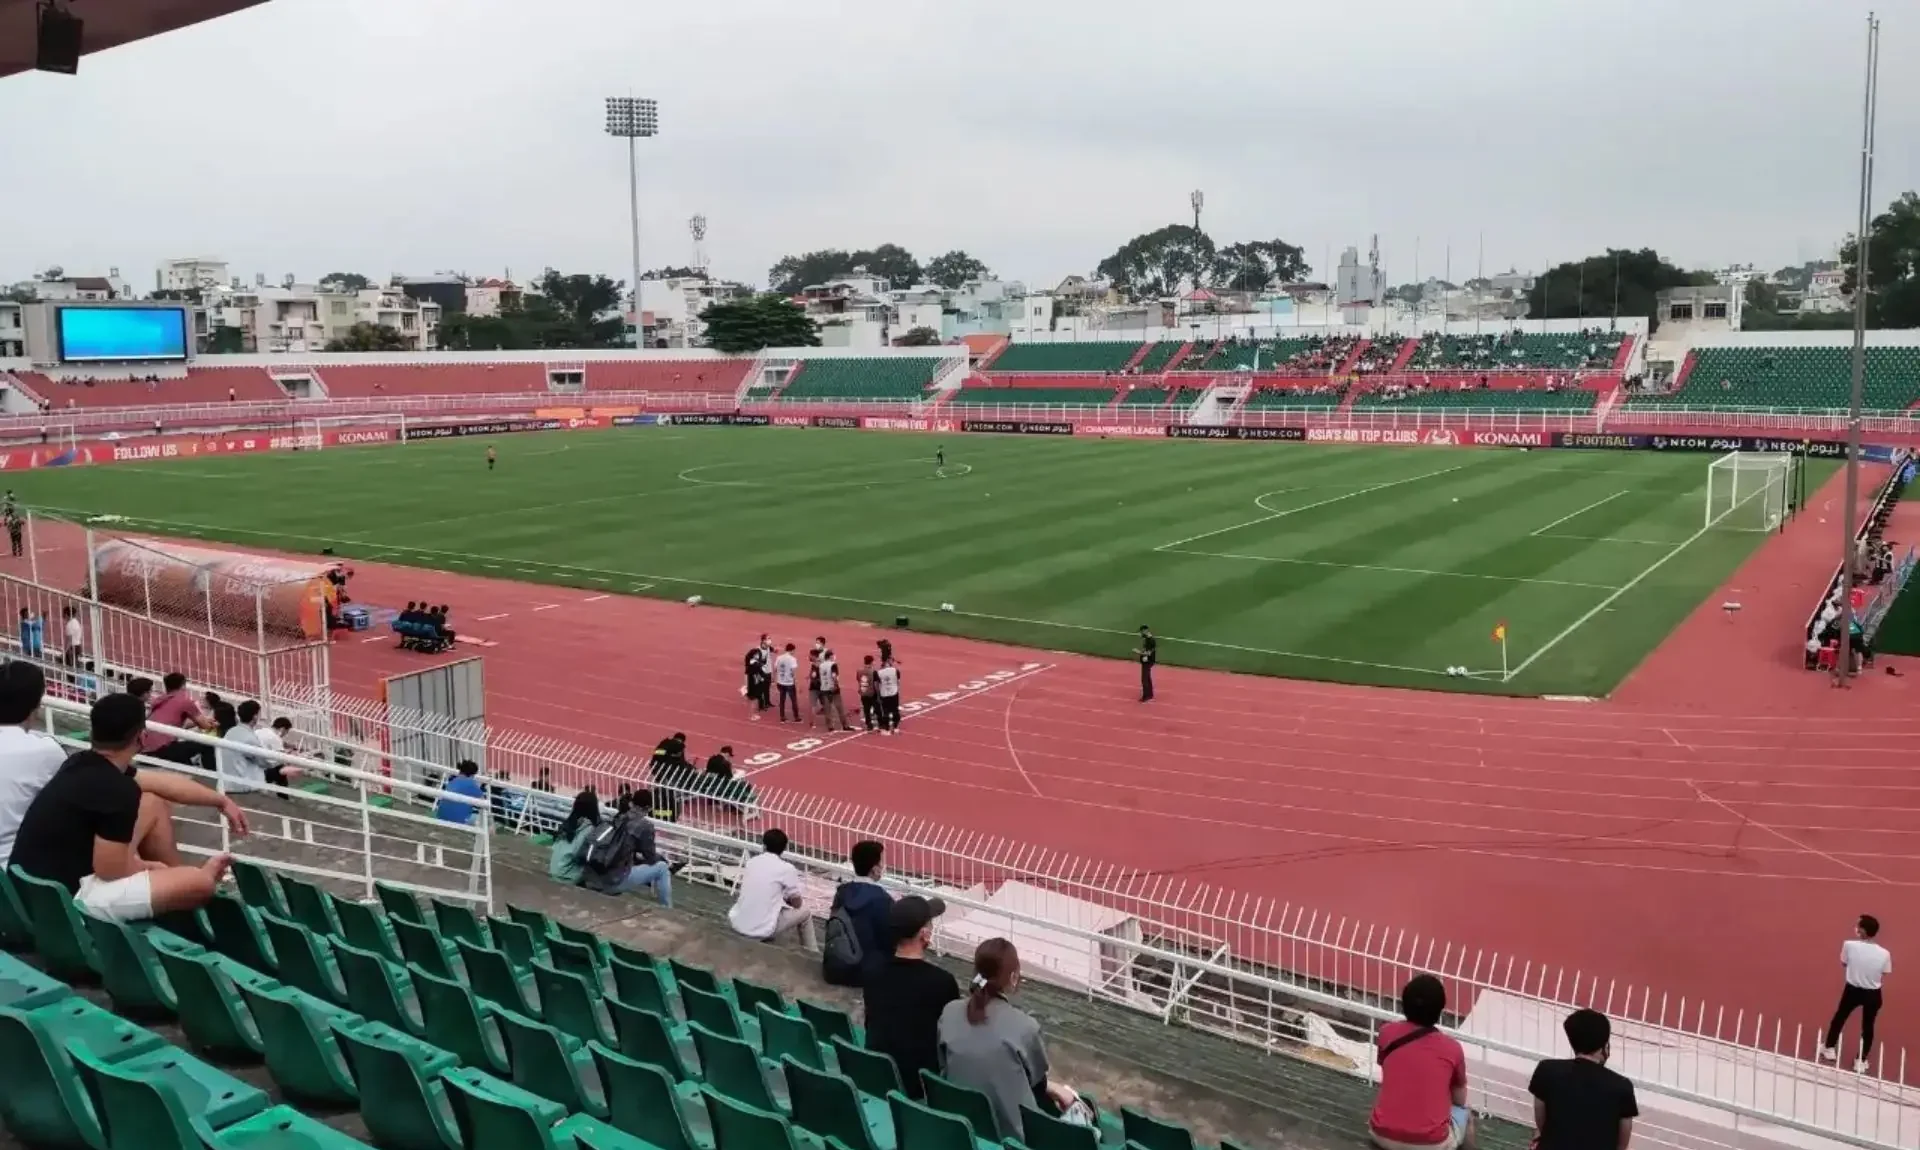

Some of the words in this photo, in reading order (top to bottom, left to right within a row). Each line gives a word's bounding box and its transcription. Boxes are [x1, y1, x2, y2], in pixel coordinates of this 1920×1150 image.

[338, 431, 389, 444] KONAMI
[1250, 430, 1301, 438] NEOM.COM
[1307, 428, 1341, 441] ASIA'S
[1360, 430, 1380, 442] TOP
[1382, 430, 1418, 442] CLUBS
[1474, 432, 1541, 445] KONAMI
[1670, 438, 1706, 448] NEOM
[1770, 442, 1806, 451] NEOM
[113, 446, 160, 460] FOLLOW
[162, 444, 178, 457] US
[787, 737, 823, 751] 8
